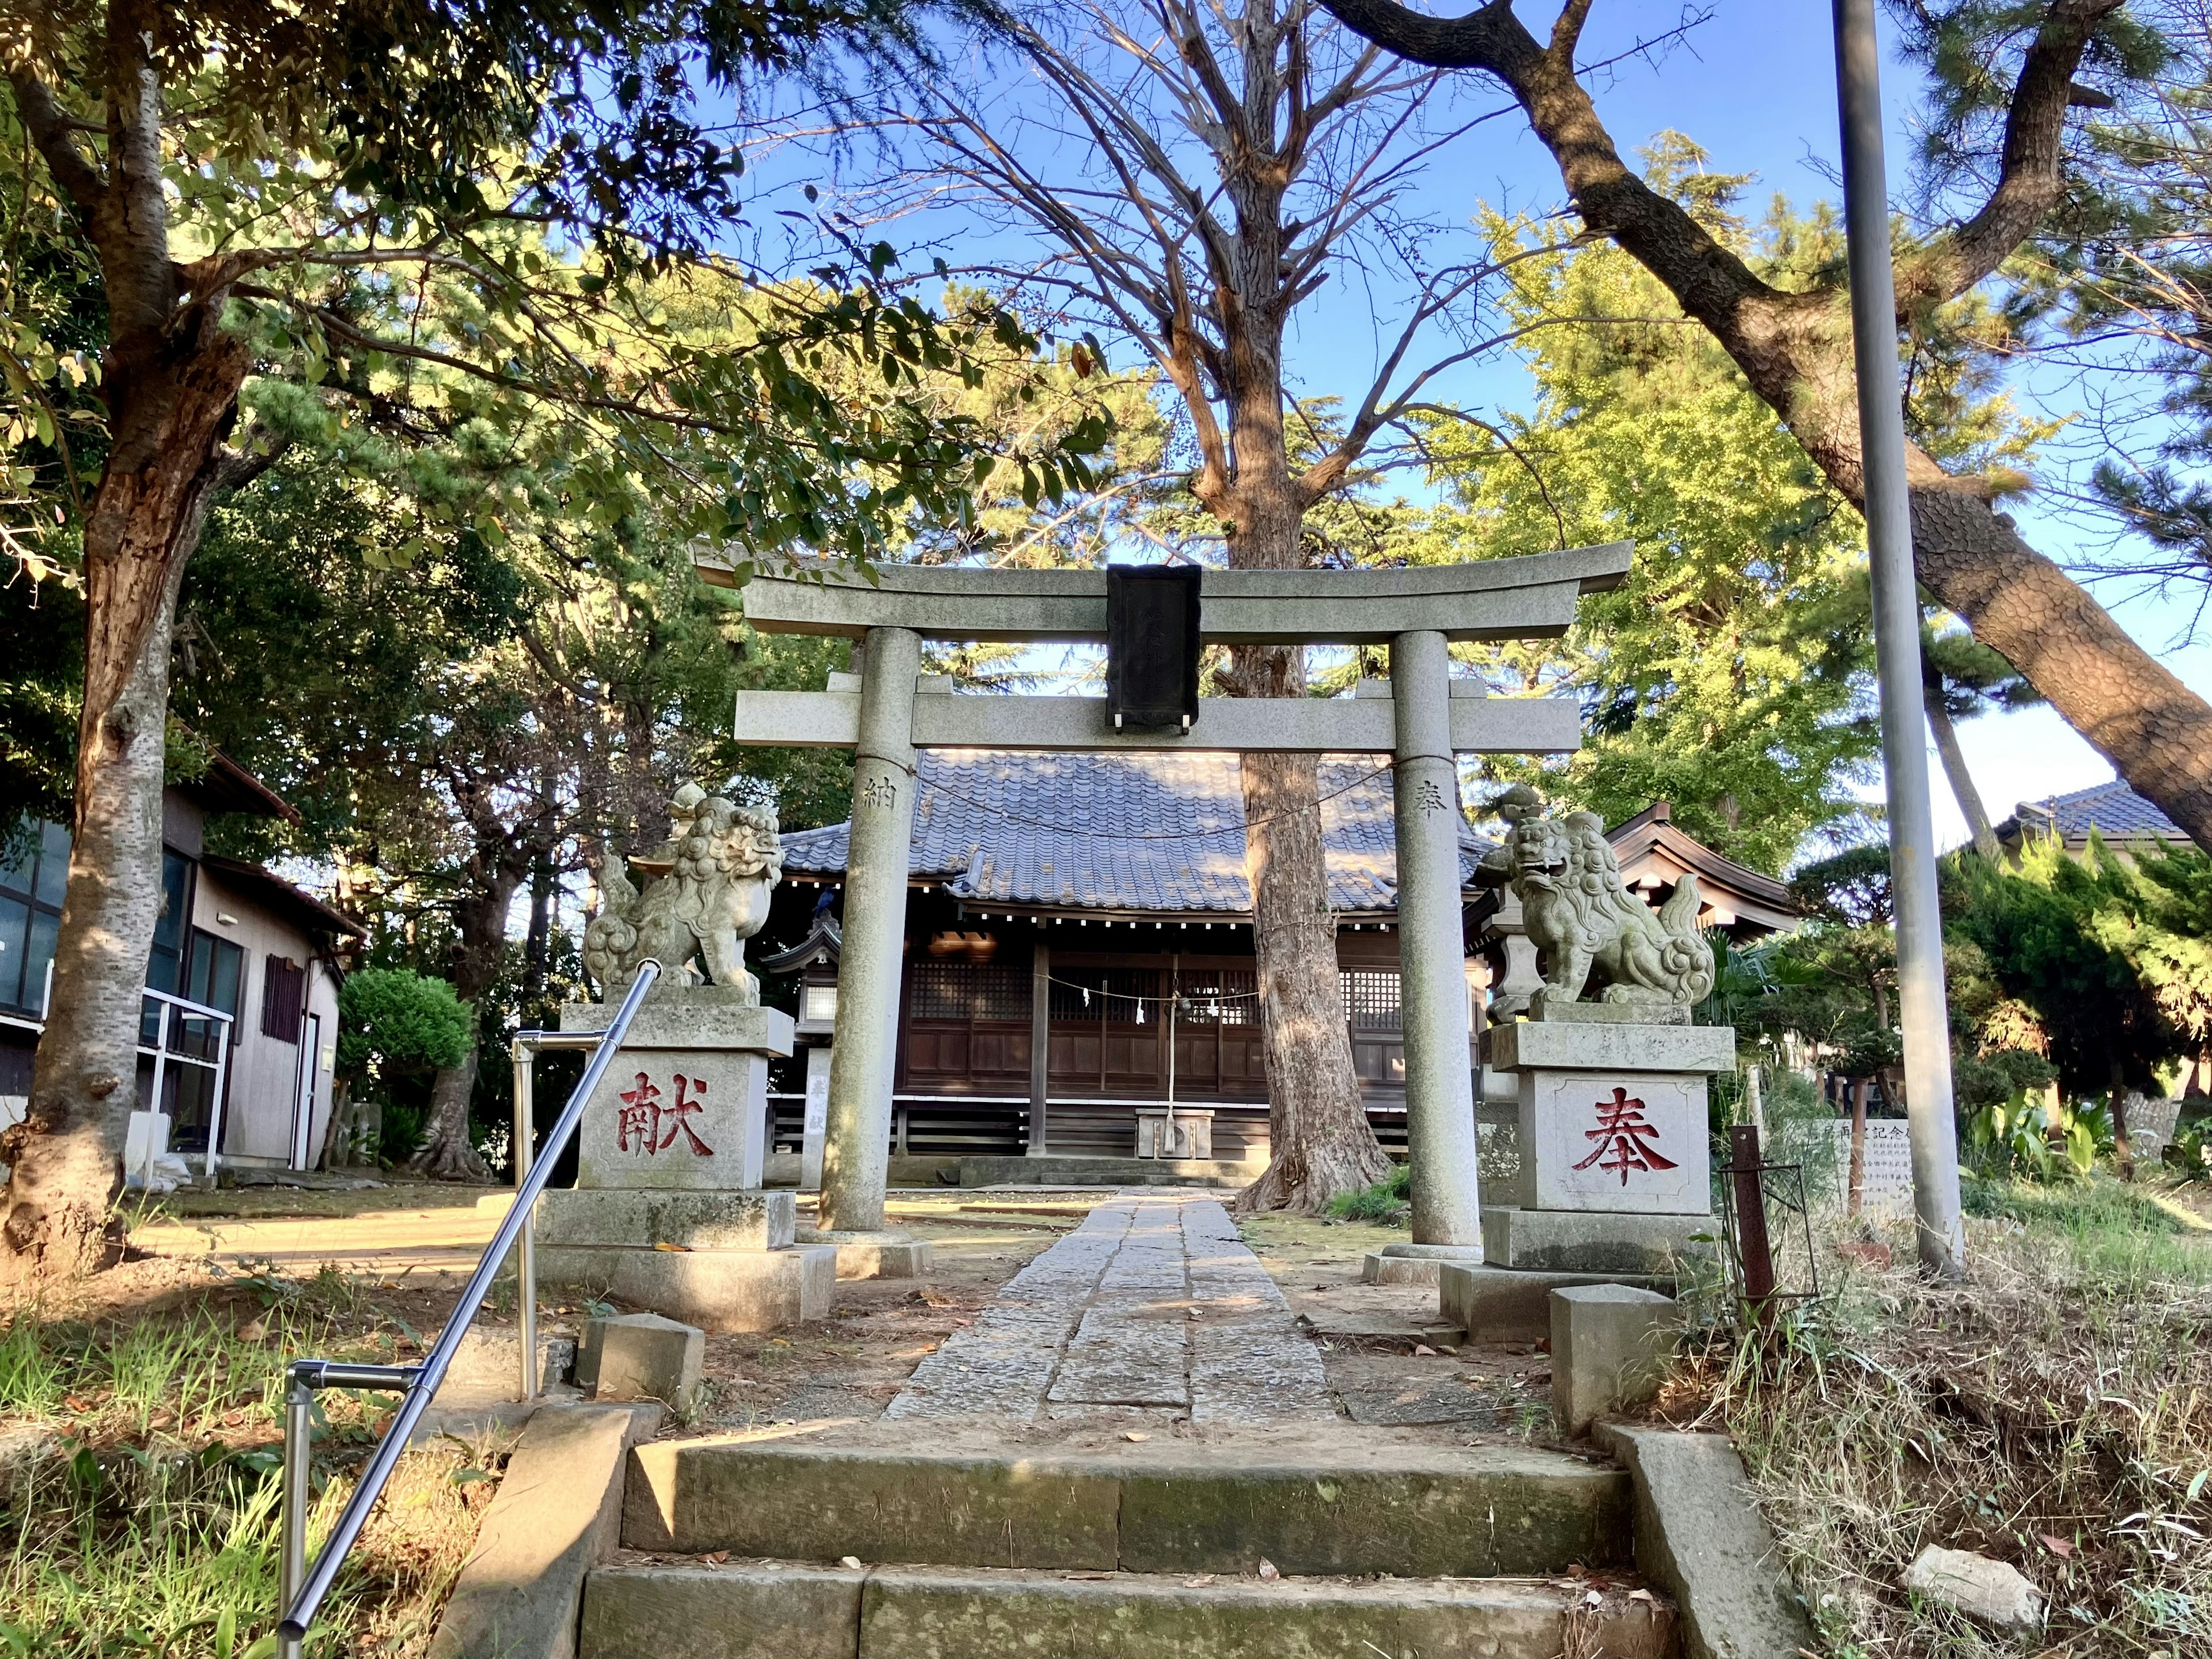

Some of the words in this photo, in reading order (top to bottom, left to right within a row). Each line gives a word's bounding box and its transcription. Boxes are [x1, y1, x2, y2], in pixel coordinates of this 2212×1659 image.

[863, 777, 896, 810] 納
[1415, 780, 1447, 819] 奉
[618, 1072, 714, 1156] 献
[1571, 1087, 1679, 1187] 奉
